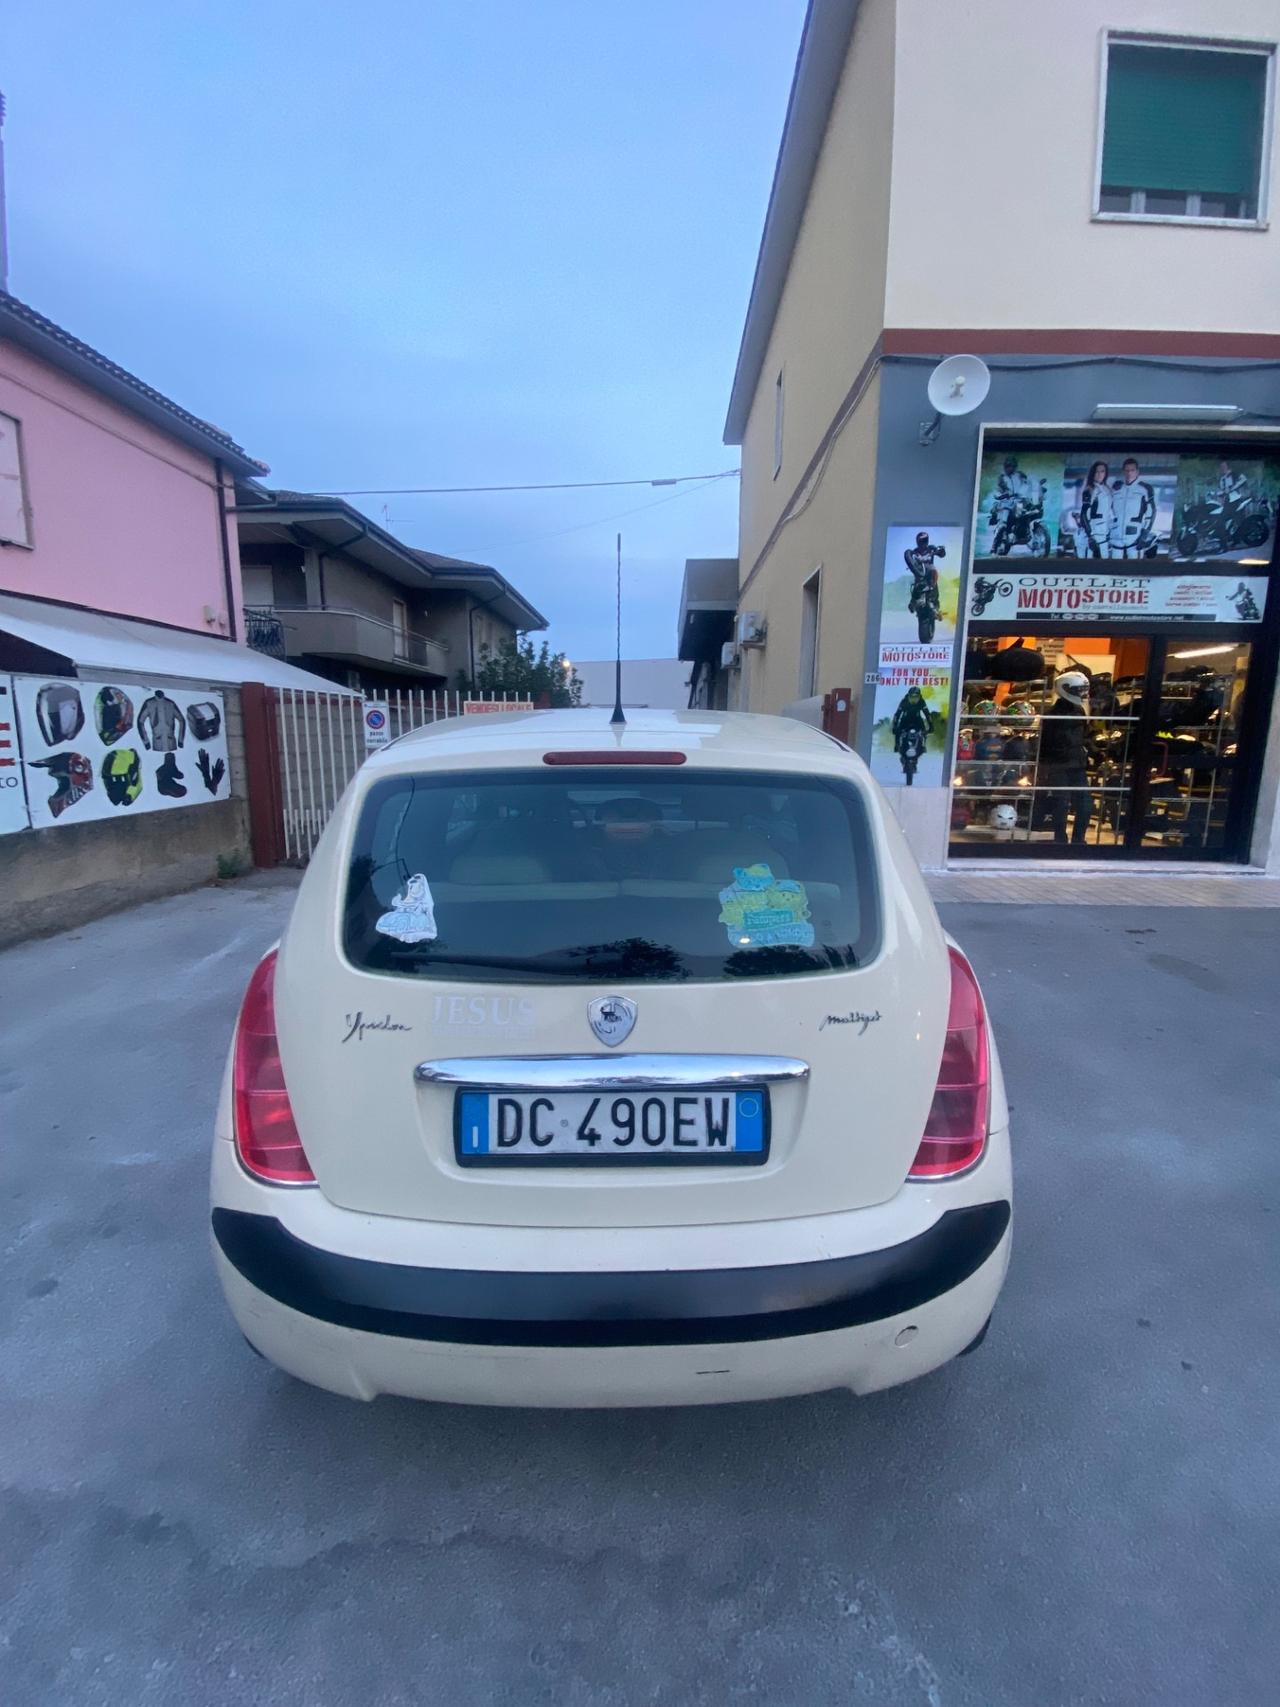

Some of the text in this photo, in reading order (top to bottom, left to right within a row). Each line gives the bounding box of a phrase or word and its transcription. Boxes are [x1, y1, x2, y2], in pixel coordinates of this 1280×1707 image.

[1018, 577, 1151, 589] OUTLET
[1017, 588, 1150, 609] MOTOSTORE
[882, 651, 950, 663] MOTOSTORE
[892, 667, 909, 677] FOR
[903, 677, 920, 686] THE
[922, 677, 949, 686] BEST!
[432, 995, 536, 1025] JESUS
